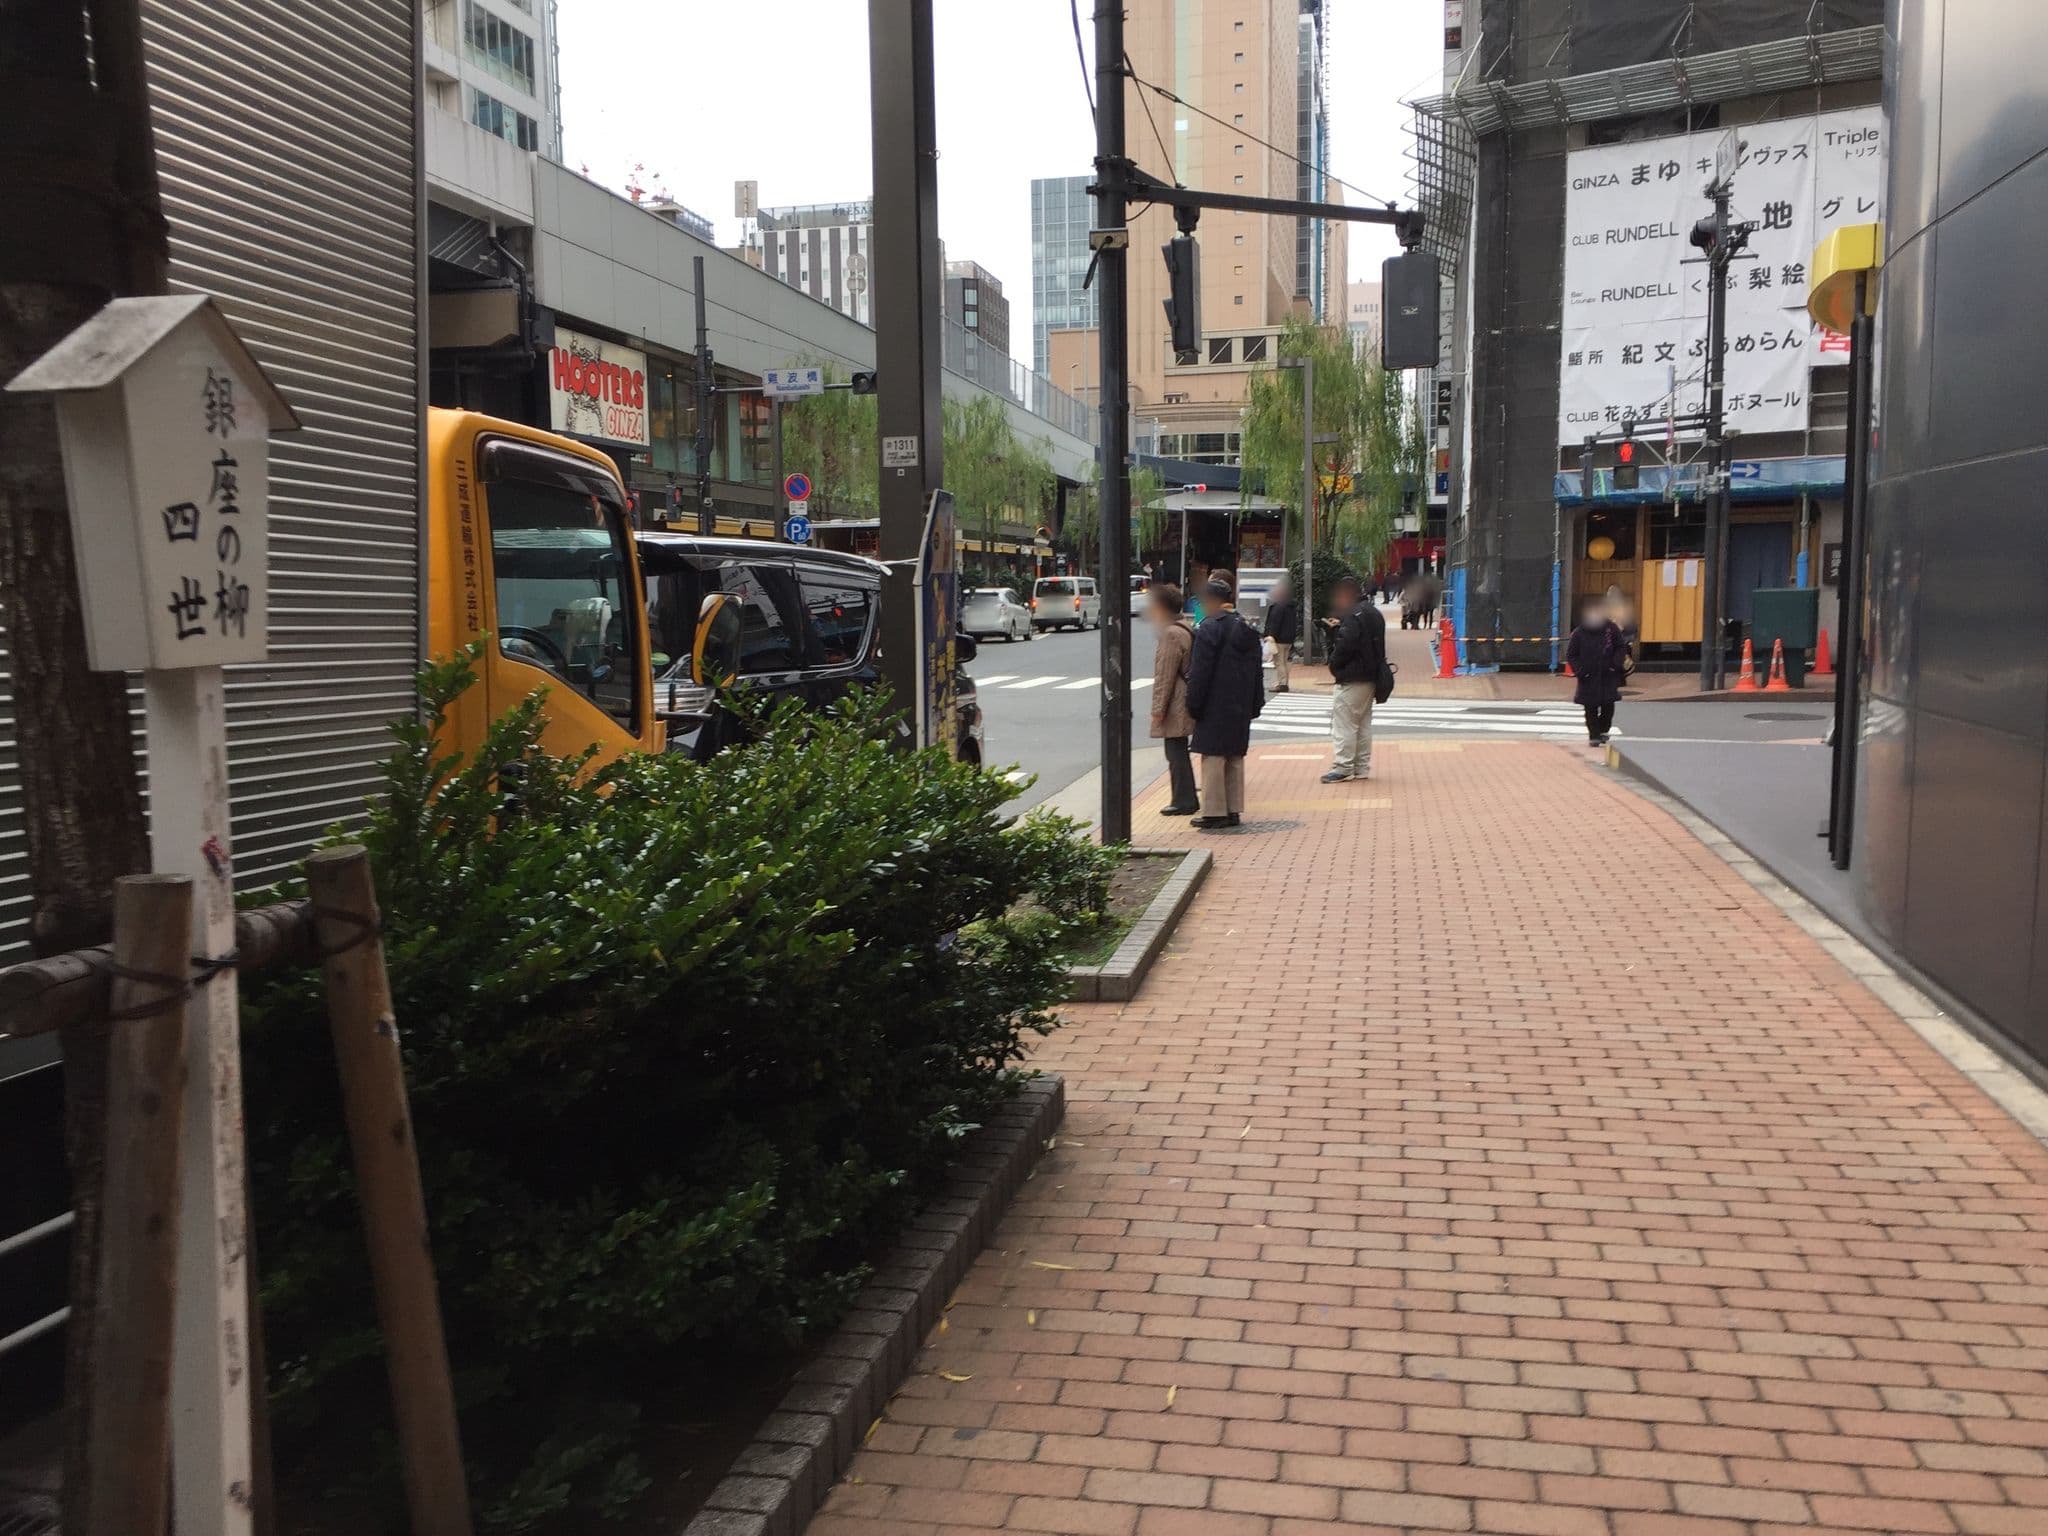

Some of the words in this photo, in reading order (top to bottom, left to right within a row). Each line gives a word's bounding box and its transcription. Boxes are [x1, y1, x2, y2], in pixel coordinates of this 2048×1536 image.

[1823, 127, 1879, 146] Triple
[1845, 145, 1880, 159] トリプ
[1572, 173, 1620, 190] GINZA
[1631, 159, 1681, 186] まゆ
[1572, 233, 1600, 246] CLUB
[1605, 221, 1680, 245] RUNDELL
[1601, 282, 1678, 303] RUNDELL
[1621, 341, 1676, 365] 紀文
[552, 345, 645, 410] HOOTERS
[1727, 391, 1802, 411] ボヌール
[606, 406, 645, 442] GINZA
[1566, 411, 1599, 423] CLUB
[893, 439, 914, 450] 1311
[203, 367, 250, 639] 銀座の柳
[161, 501, 208, 641] 四世
